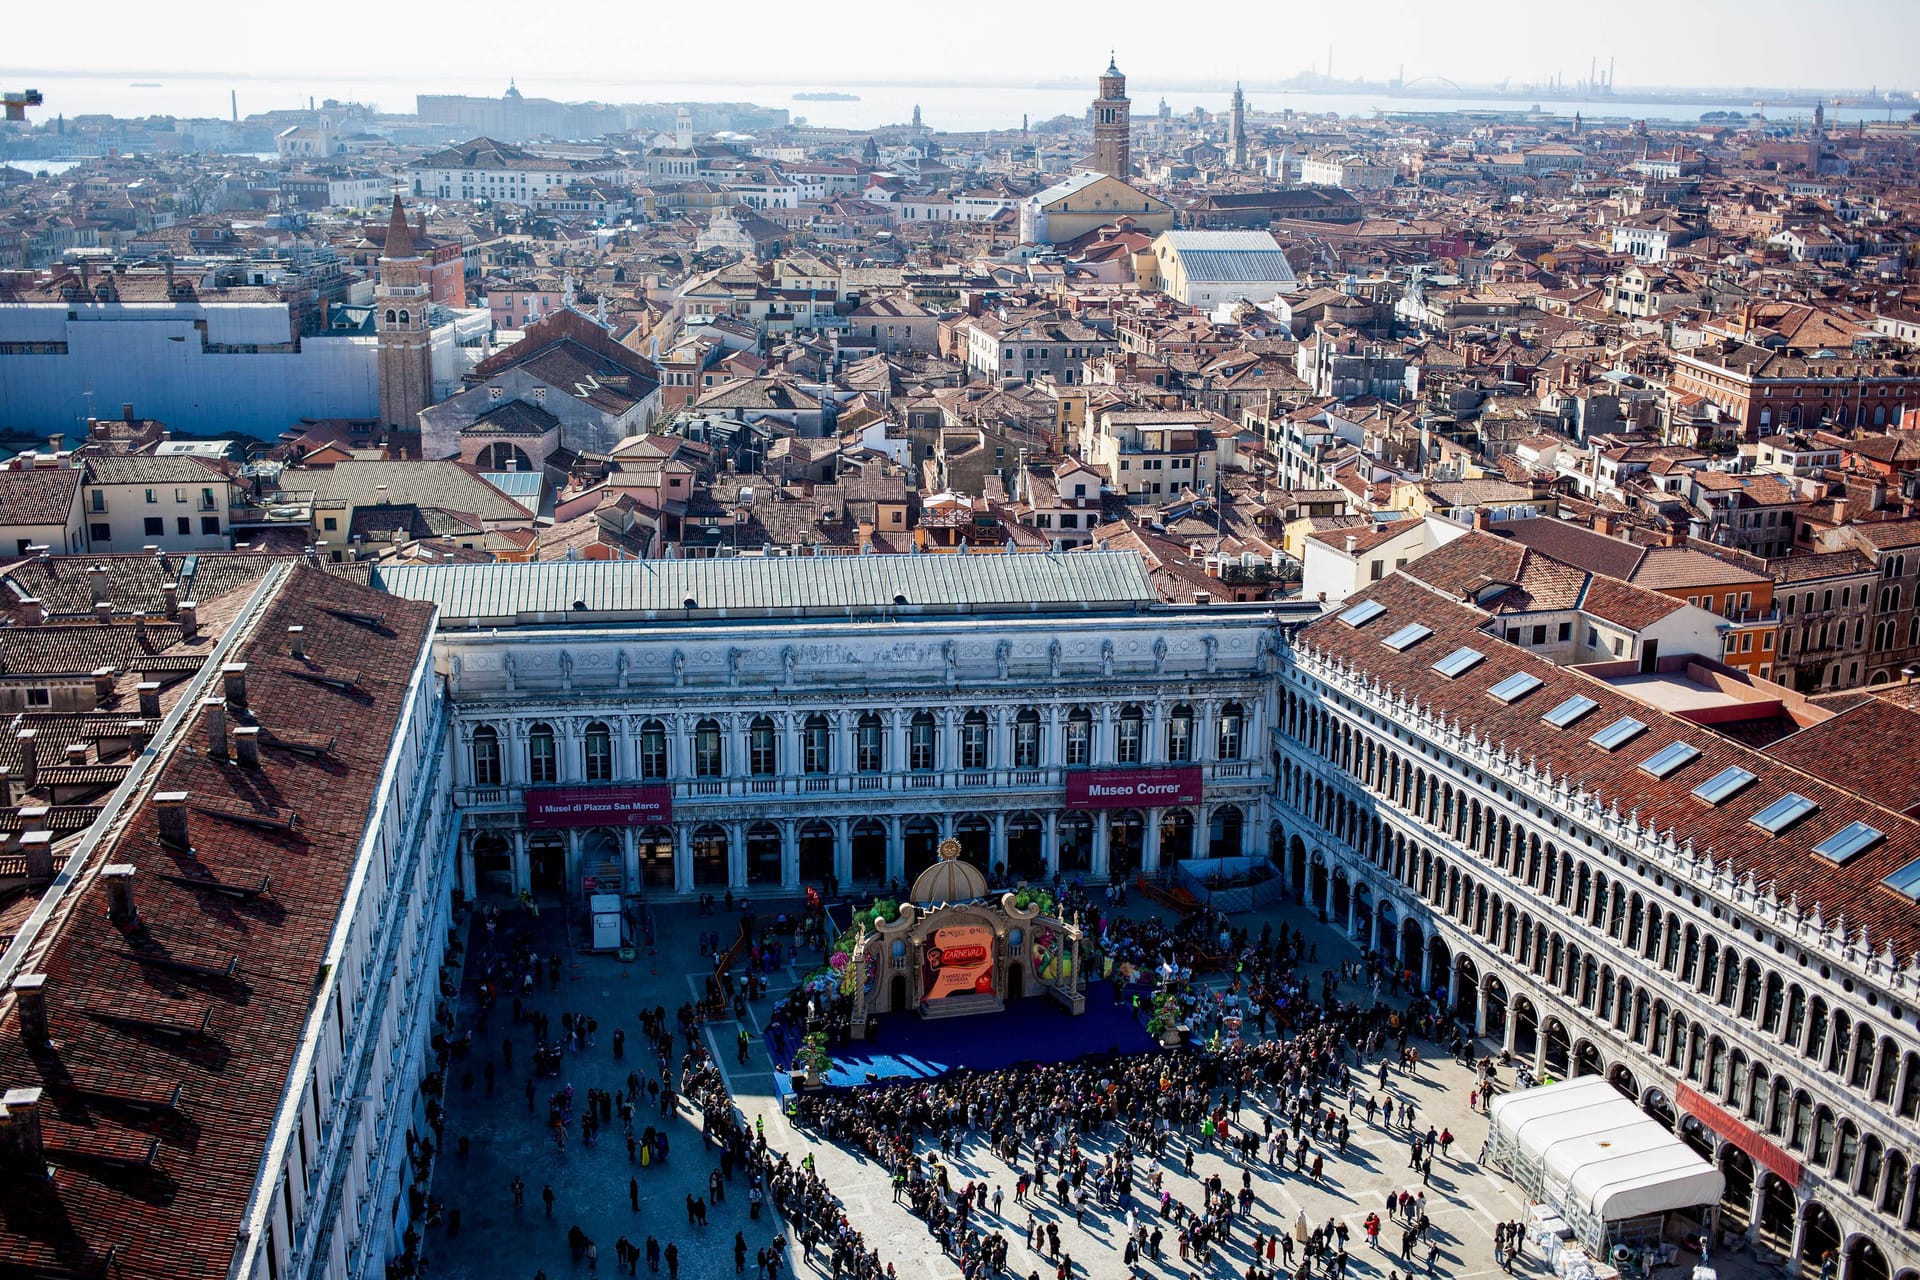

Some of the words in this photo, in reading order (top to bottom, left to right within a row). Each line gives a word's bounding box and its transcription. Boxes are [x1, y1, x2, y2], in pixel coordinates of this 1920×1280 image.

[1089, 784, 1133, 796] Museo
[1137, 783, 1180, 795] Correr
[545, 804, 571, 813] Musei
[573, 804, 581, 812] di
[584, 802, 611, 811] Piazza
[614, 802, 630, 810] San
[633, 802, 659, 810] Marco
[944, 948, 983, 960] CARNEVALI
